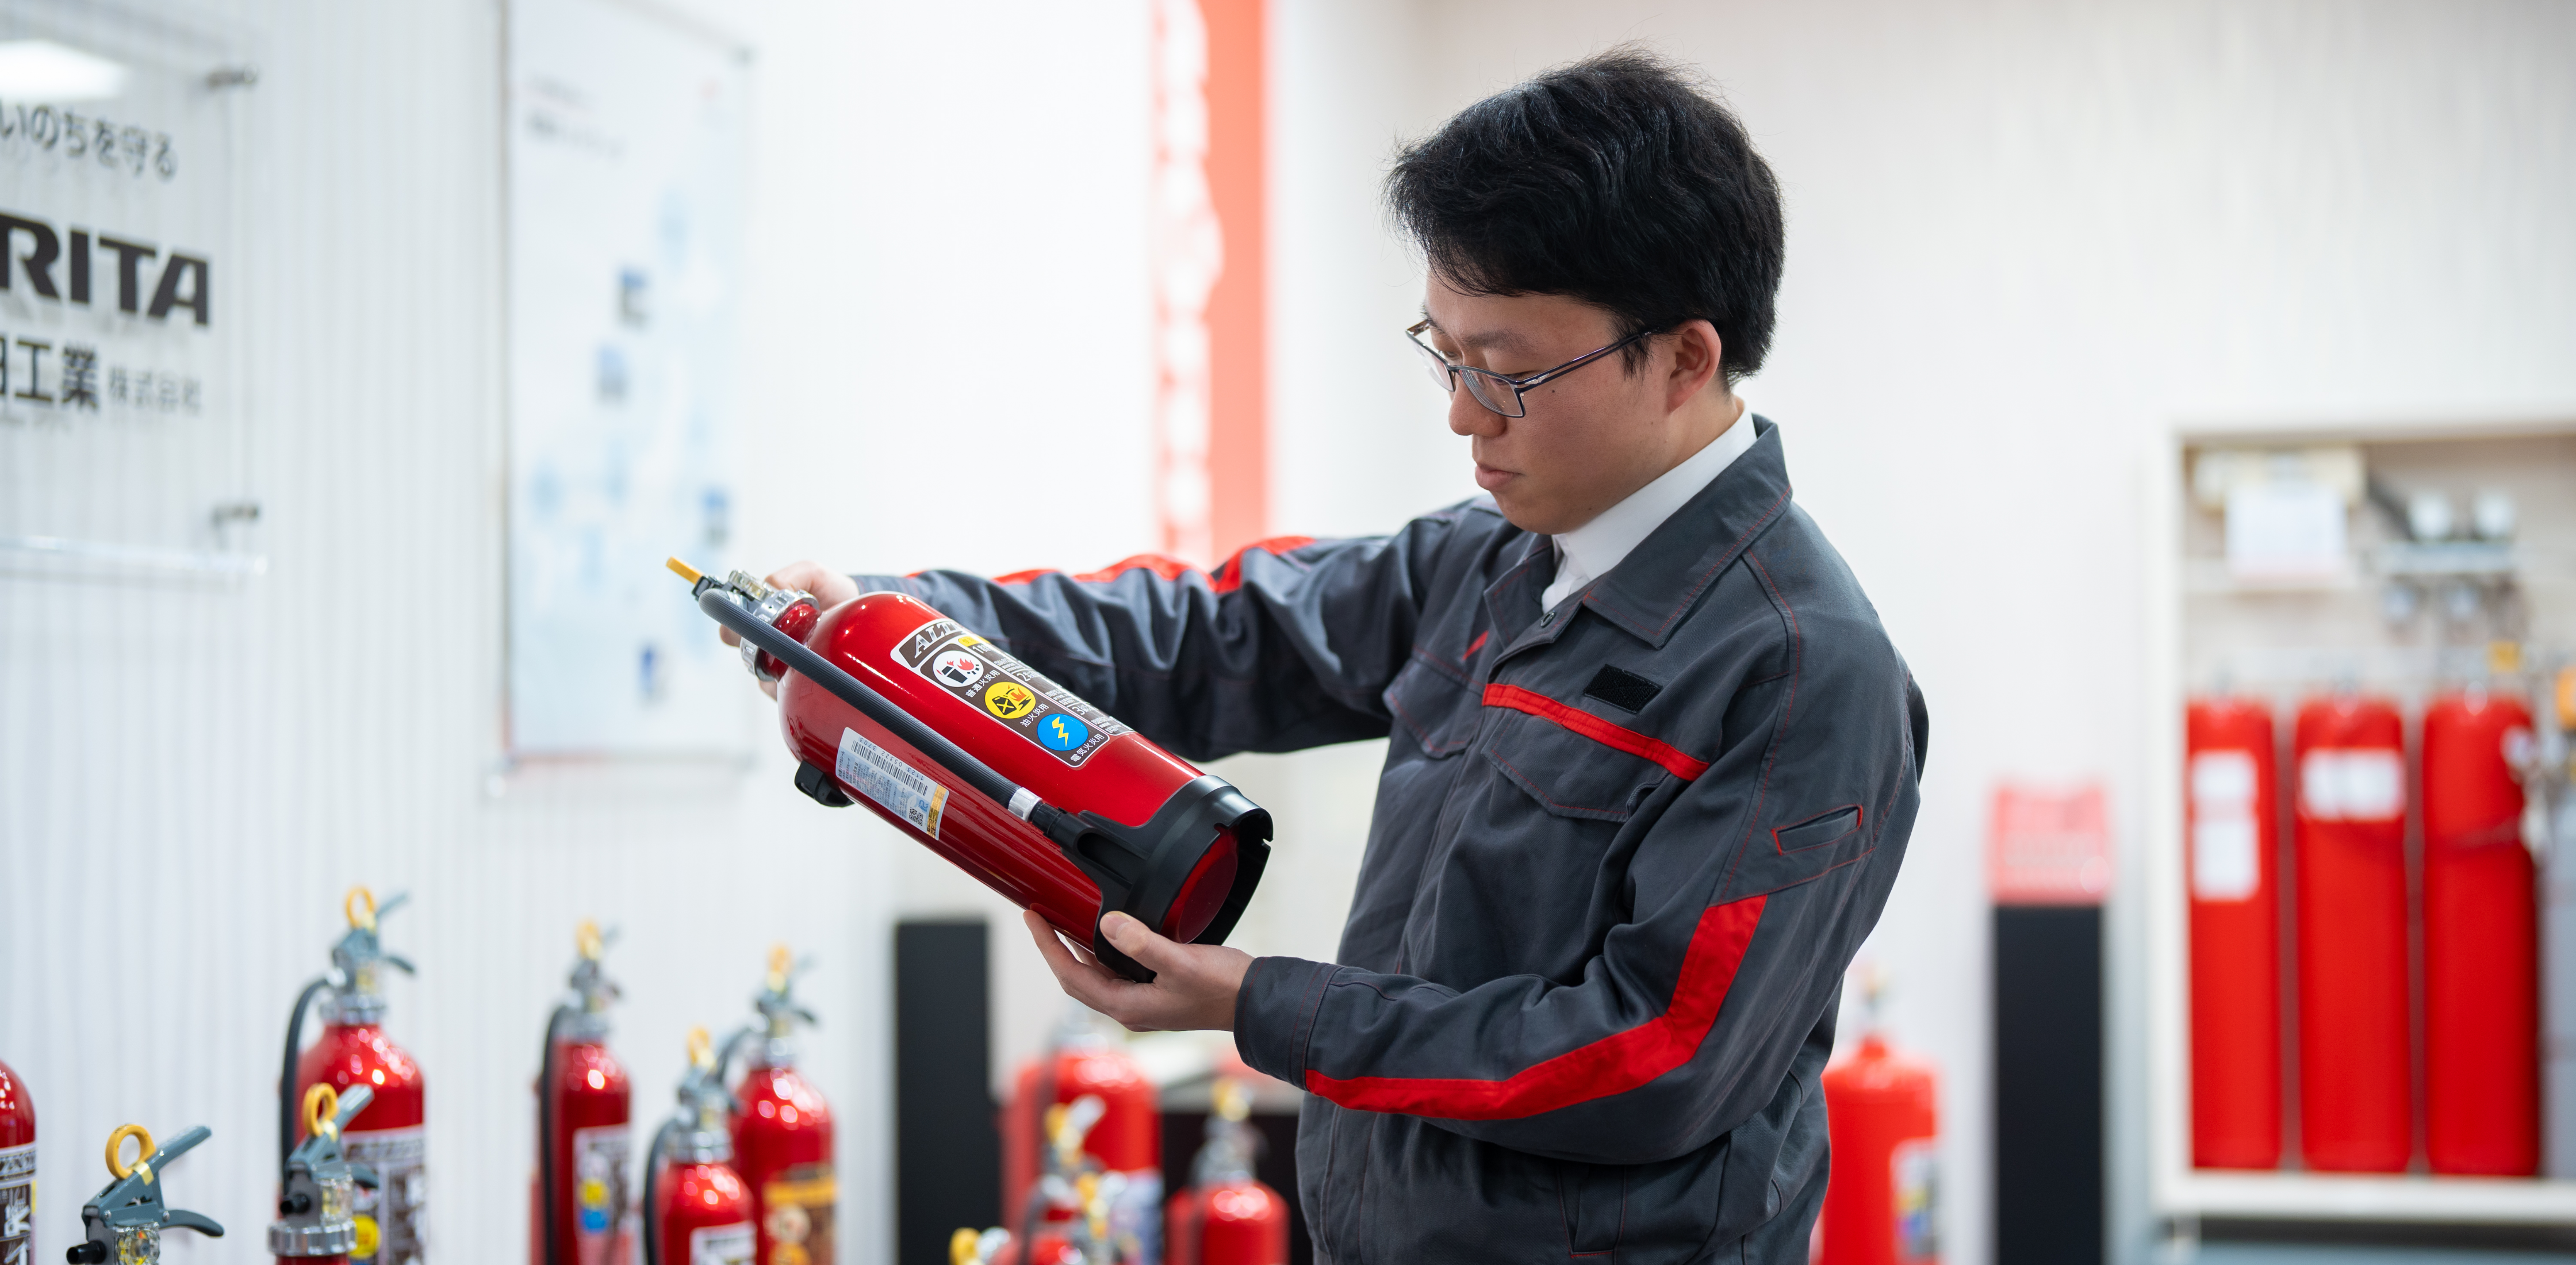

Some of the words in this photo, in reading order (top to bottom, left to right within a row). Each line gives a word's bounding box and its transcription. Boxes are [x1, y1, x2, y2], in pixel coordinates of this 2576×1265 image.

[0, 99, 177, 182] いのちを守る
[0, 213, 208, 326] RITA
[0, 334, 99, 412] 工業
[965, 669, 1000, 698] 普通火災用
[1019, 703, 1049, 727] 油火災用
[860, 737, 876, 751] 3703
[881, 750, 902, 767] 05322
[1070, 733, 1105, 762] 電気火災用
[907, 766, 923, 780] 1123
